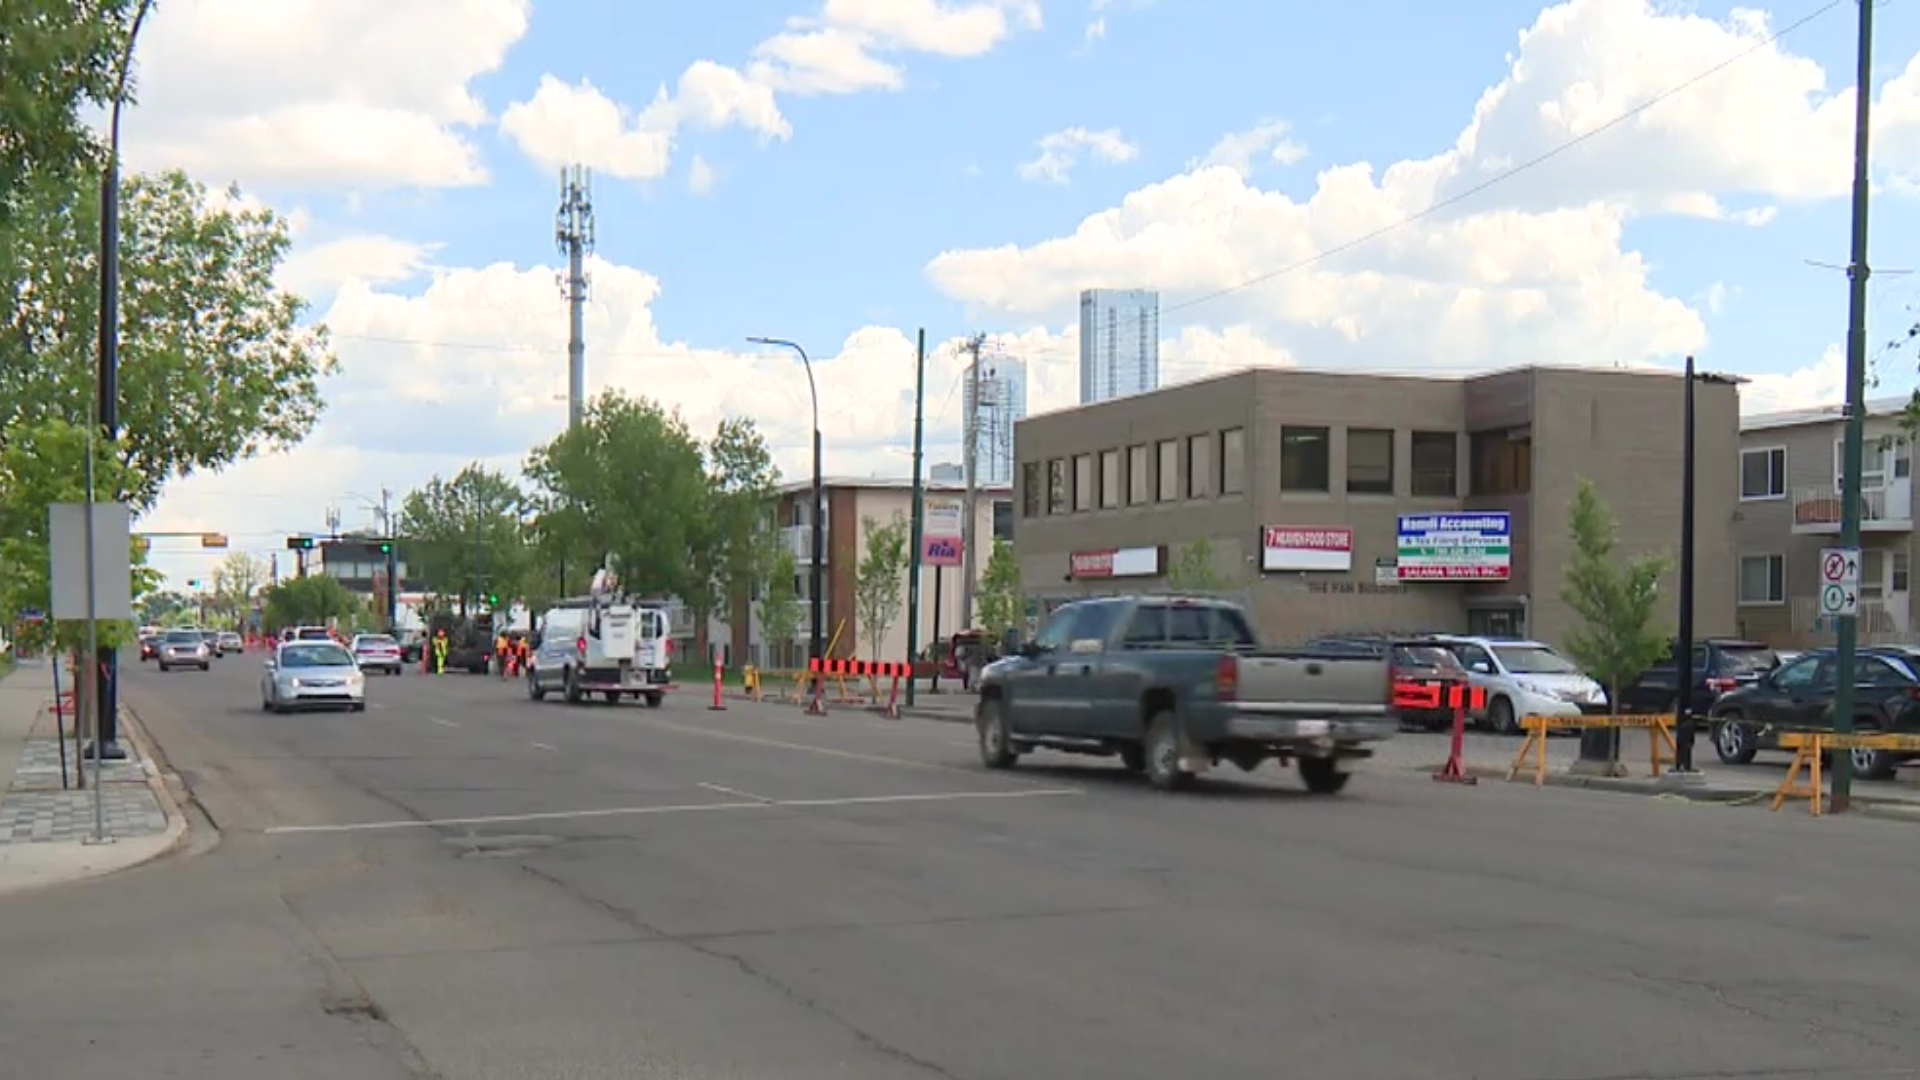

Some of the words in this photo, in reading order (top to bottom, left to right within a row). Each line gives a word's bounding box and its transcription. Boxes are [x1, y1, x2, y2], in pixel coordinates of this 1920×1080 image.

[1440, 516, 1506, 532] Accounting
[1305, 532, 1324, 547] FOOD
[1325, 532, 1349, 547] STORE
[1462, 536, 1503, 545] Services
[1403, 567, 1443, 577] SALAMA
[1446, 567, 1478, 577] TRAVEL
[1308, 582, 1327, 594] THE
